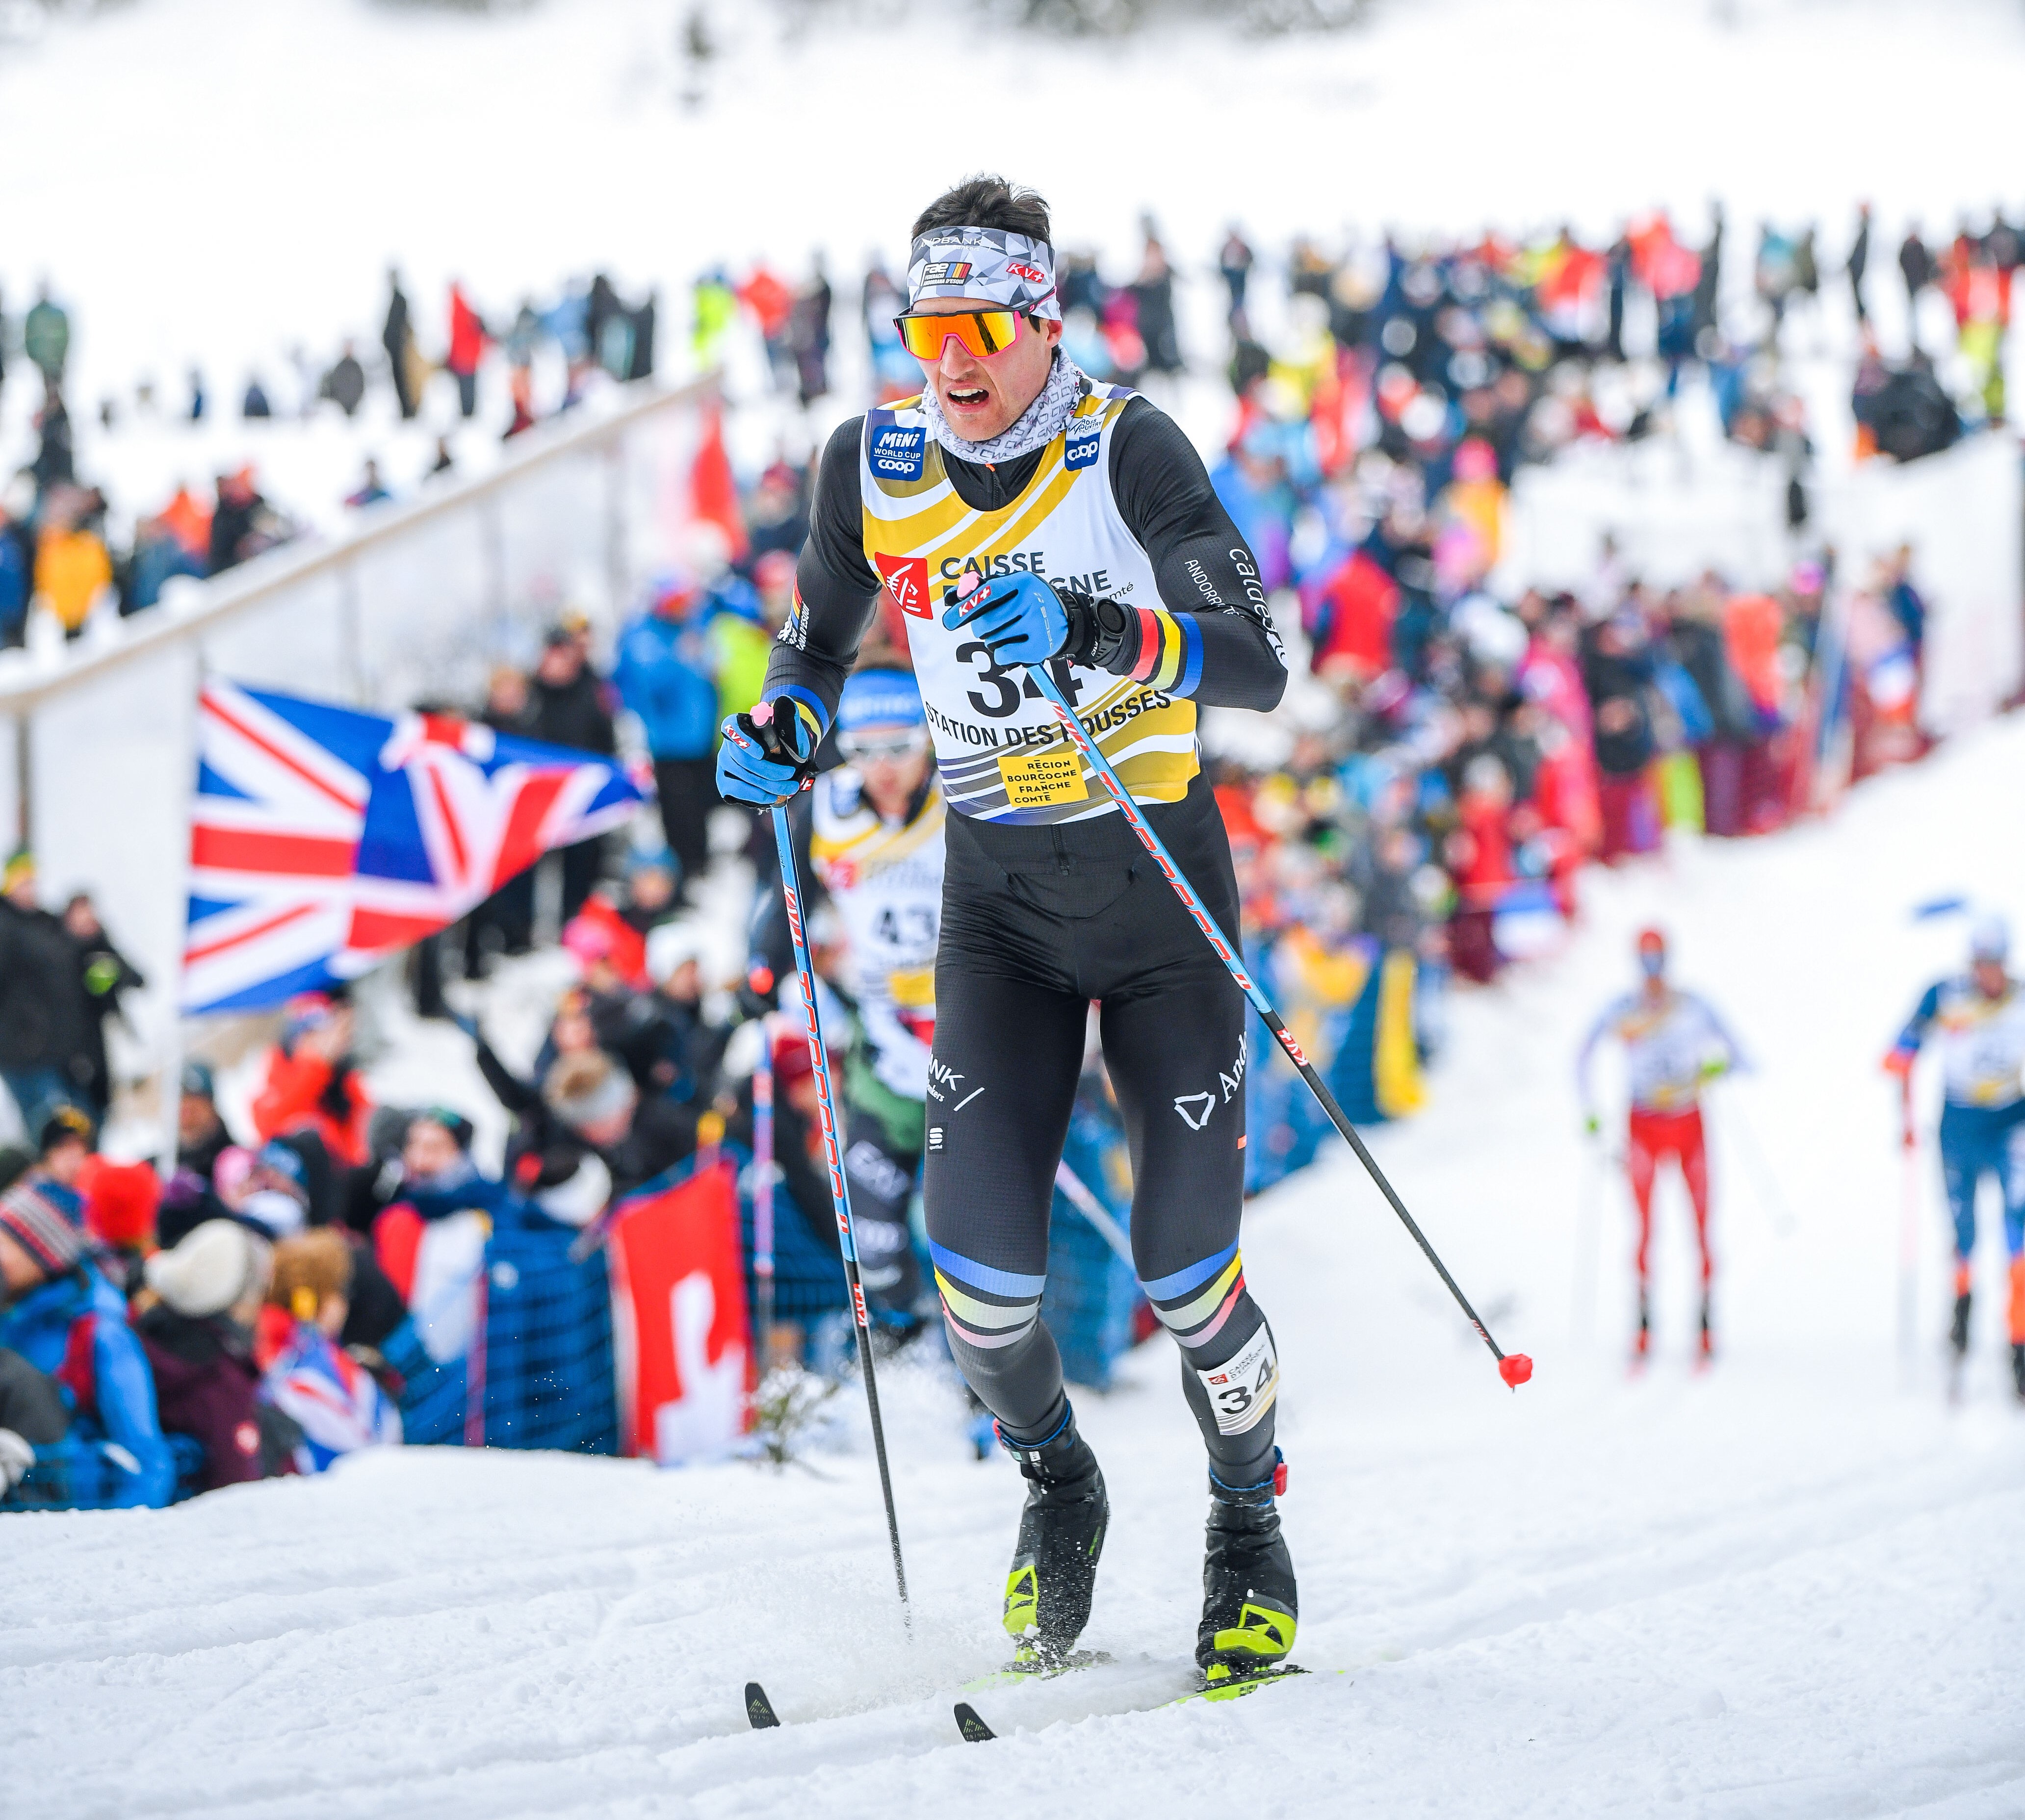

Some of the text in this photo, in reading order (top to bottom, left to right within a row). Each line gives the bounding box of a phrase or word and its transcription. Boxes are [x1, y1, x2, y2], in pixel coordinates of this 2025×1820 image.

[1008, 264, 1044, 283] KV+
[874, 447, 903, 458] WORLD
[878, 459, 915, 474] coop
[940, 552, 1045, 580] CAISSE
[959, 586, 991, 617] KV+
[956, 641, 1084, 718] 34
[926, 700, 999, 747] STATION
[1005, 724, 1054, 747] DES
[724, 724, 751, 749] KV+
[1007, 769, 1077, 782] BOURGOGNE
[1019, 781, 1071, 793] FRANCHE
[1218, 1357, 1273, 1415] 34
